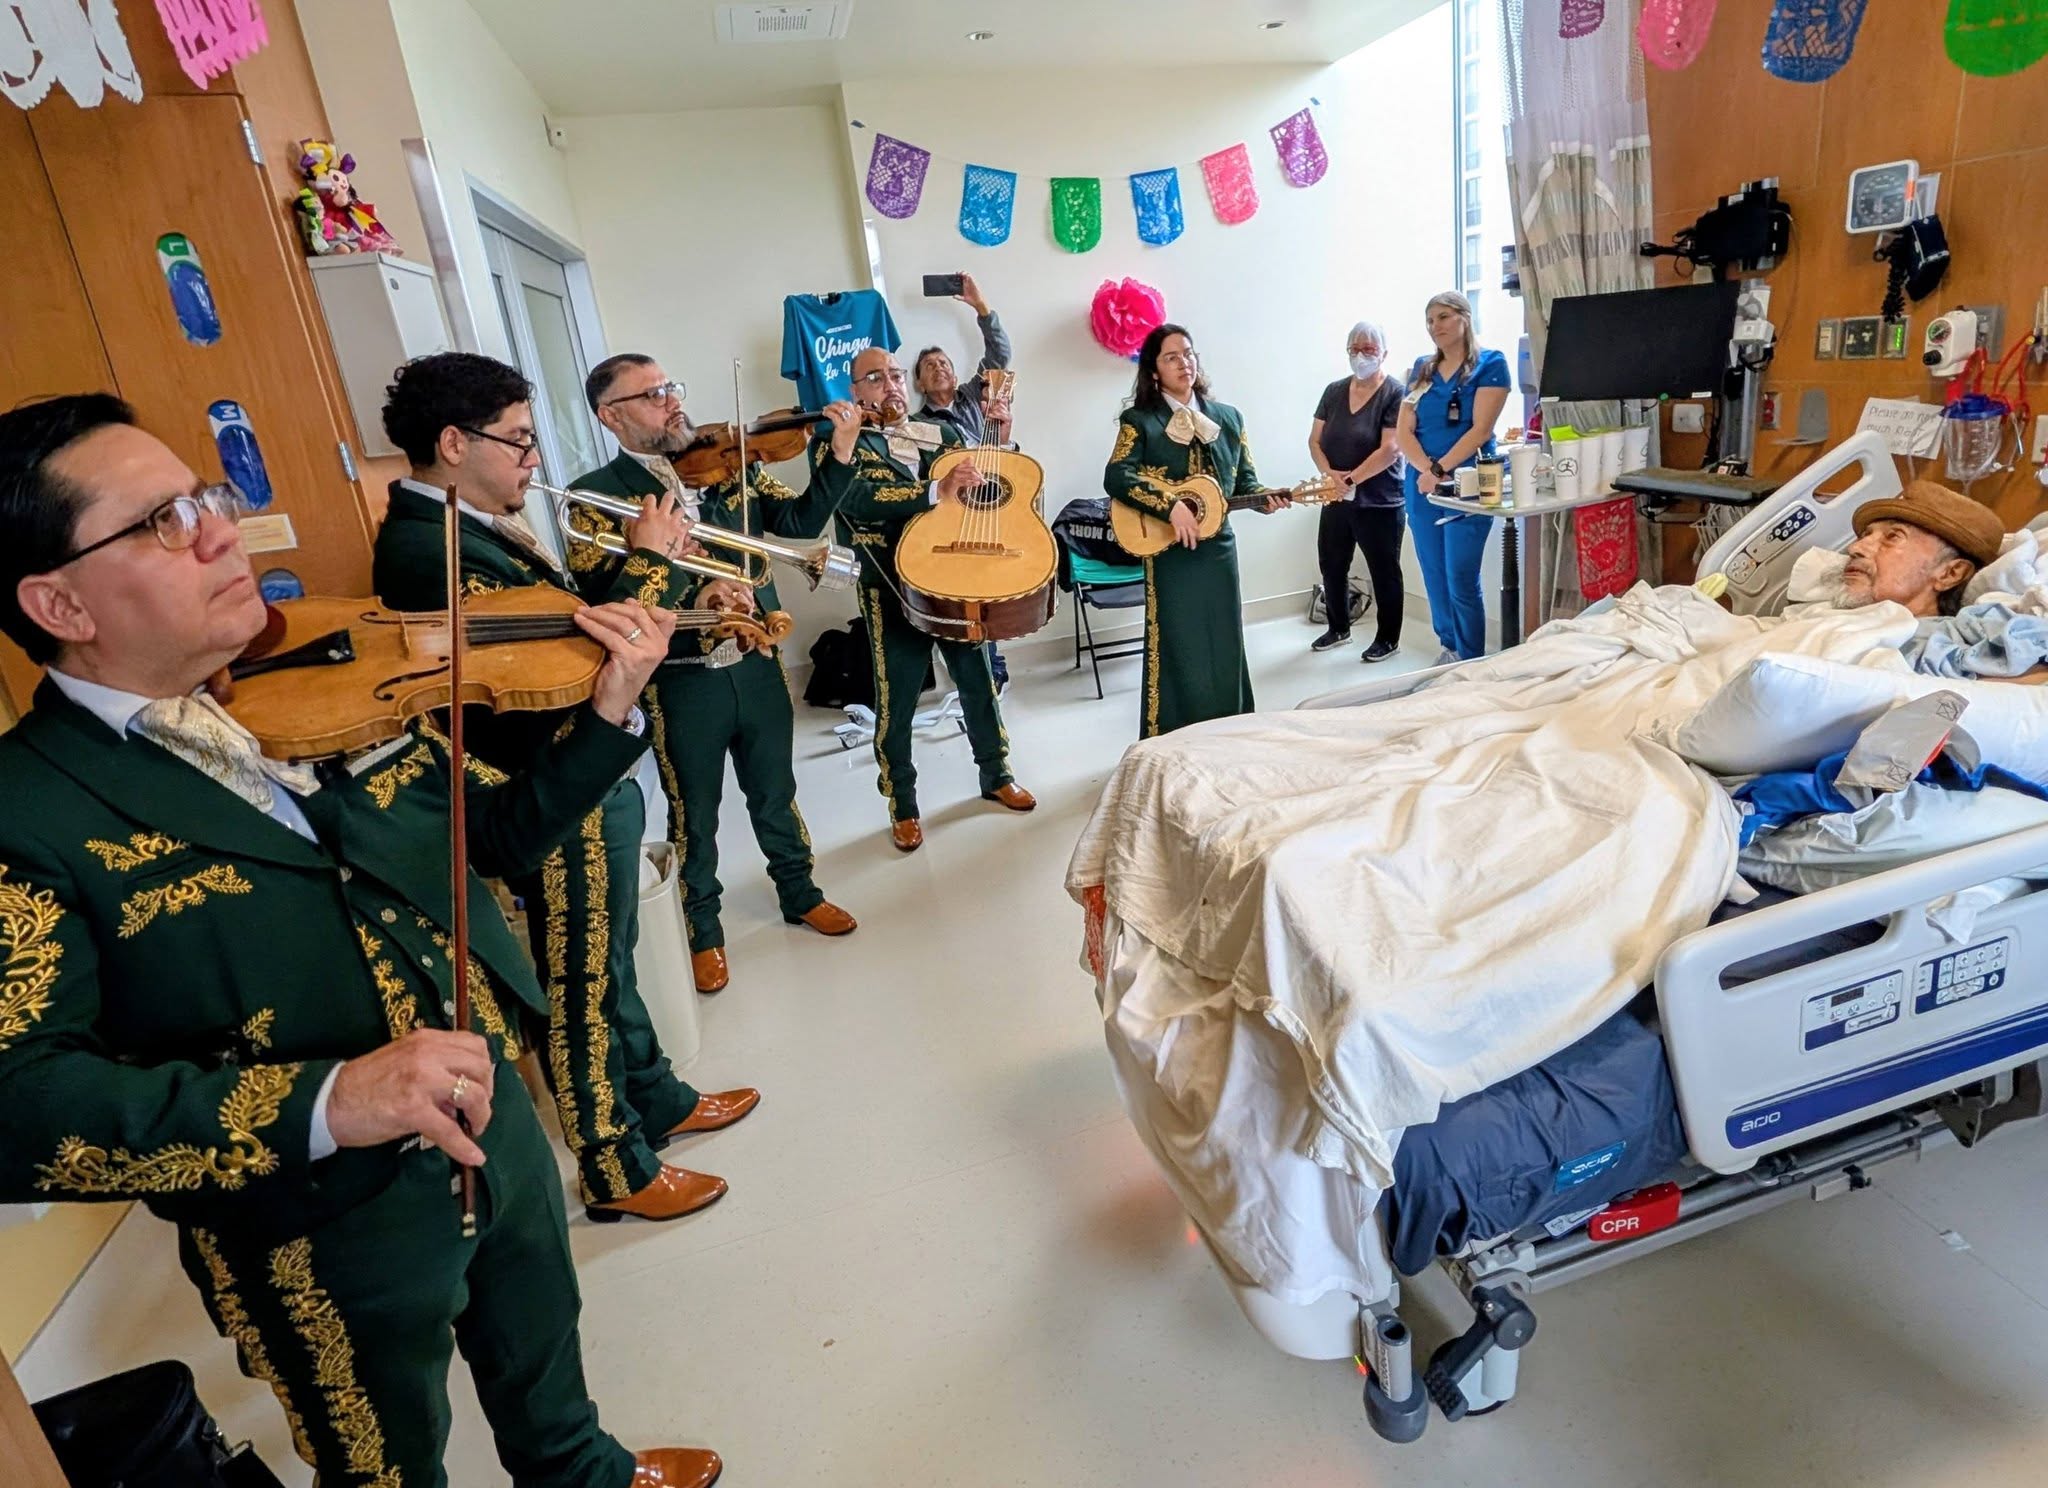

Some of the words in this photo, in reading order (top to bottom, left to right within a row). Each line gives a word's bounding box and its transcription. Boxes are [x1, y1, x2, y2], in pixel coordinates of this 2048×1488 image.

[815, 336, 872, 363] Chinga
[220, 404, 238, 419] M
[1069, 523, 1104, 541] MORE
[1601, 1216, 1640, 1234] CPR
